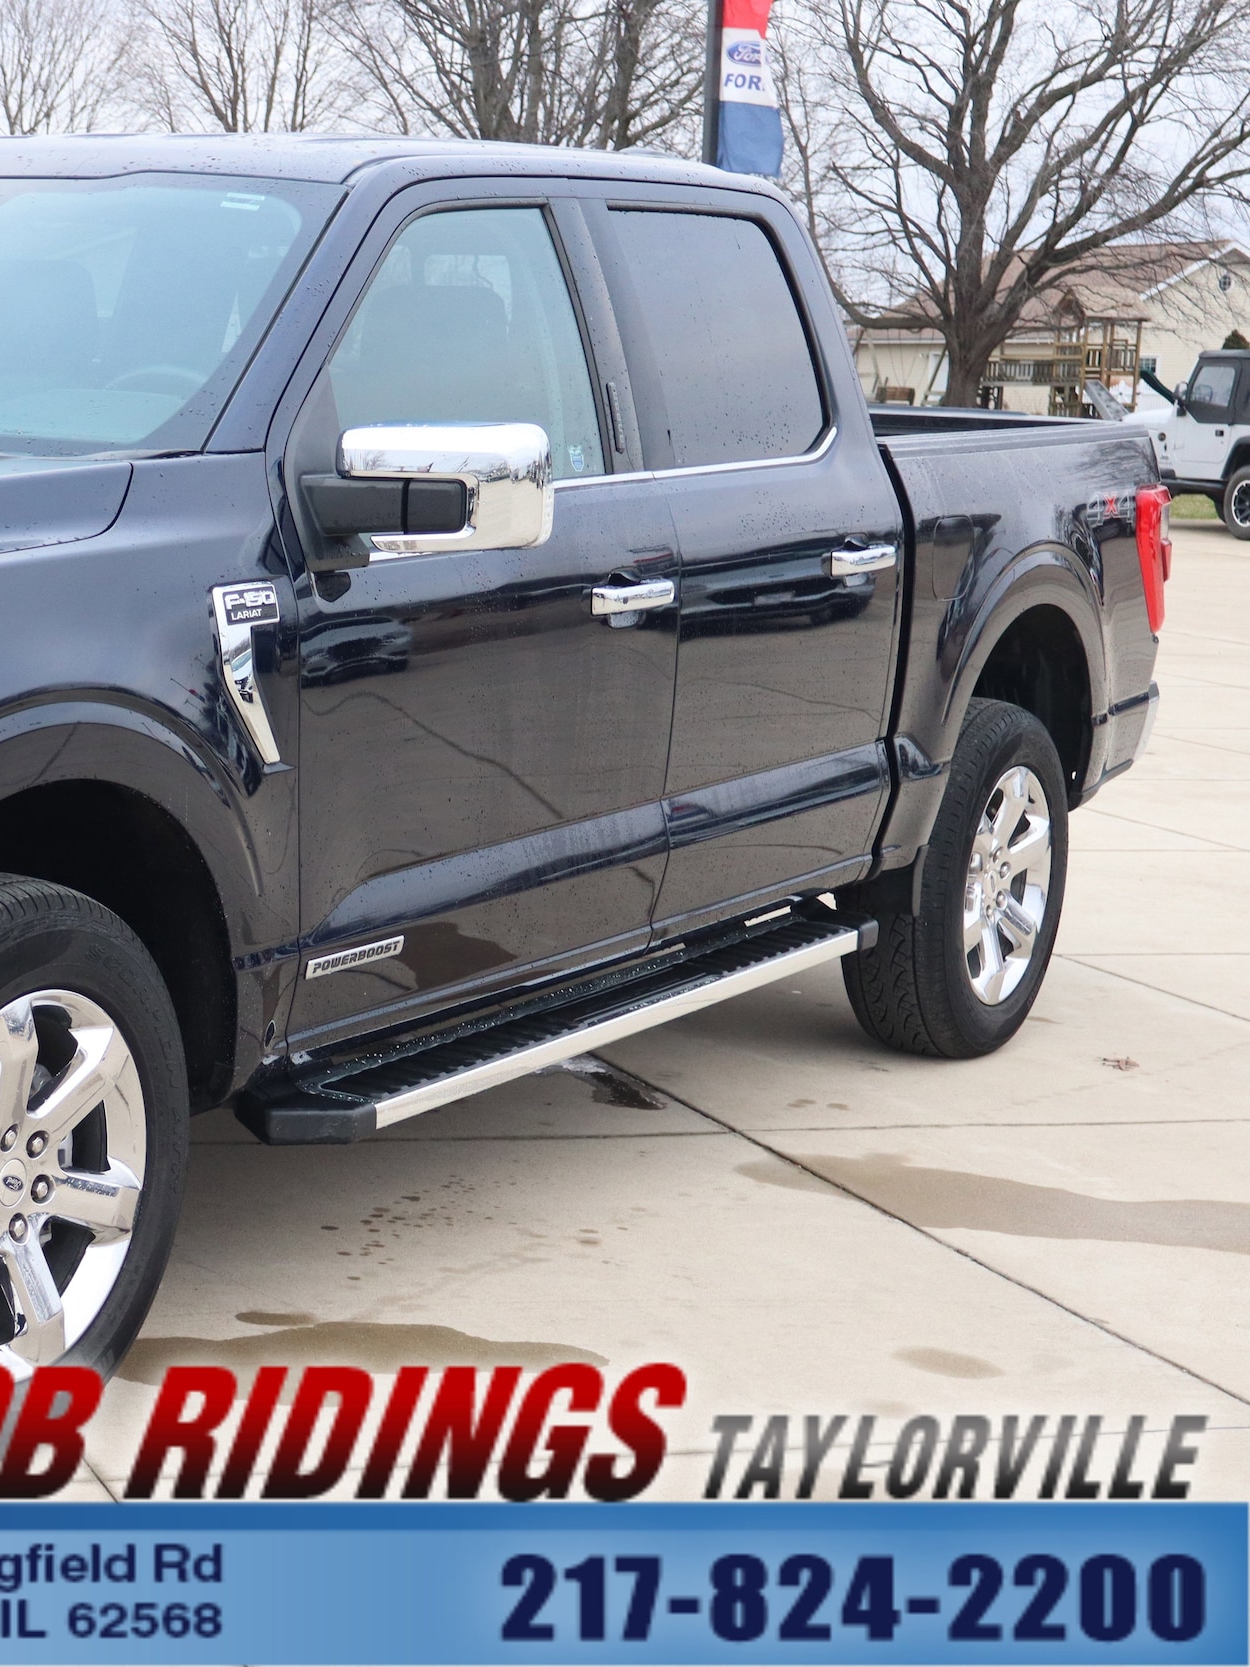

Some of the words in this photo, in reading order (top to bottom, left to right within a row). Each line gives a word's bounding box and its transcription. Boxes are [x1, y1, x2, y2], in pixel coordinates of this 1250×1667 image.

[724, 72, 766, 92] FOR
[225, 591, 275, 609] F-150
[231, 608, 263, 621] LARIAT
[312, 941, 400, 974] POWERBOOST
